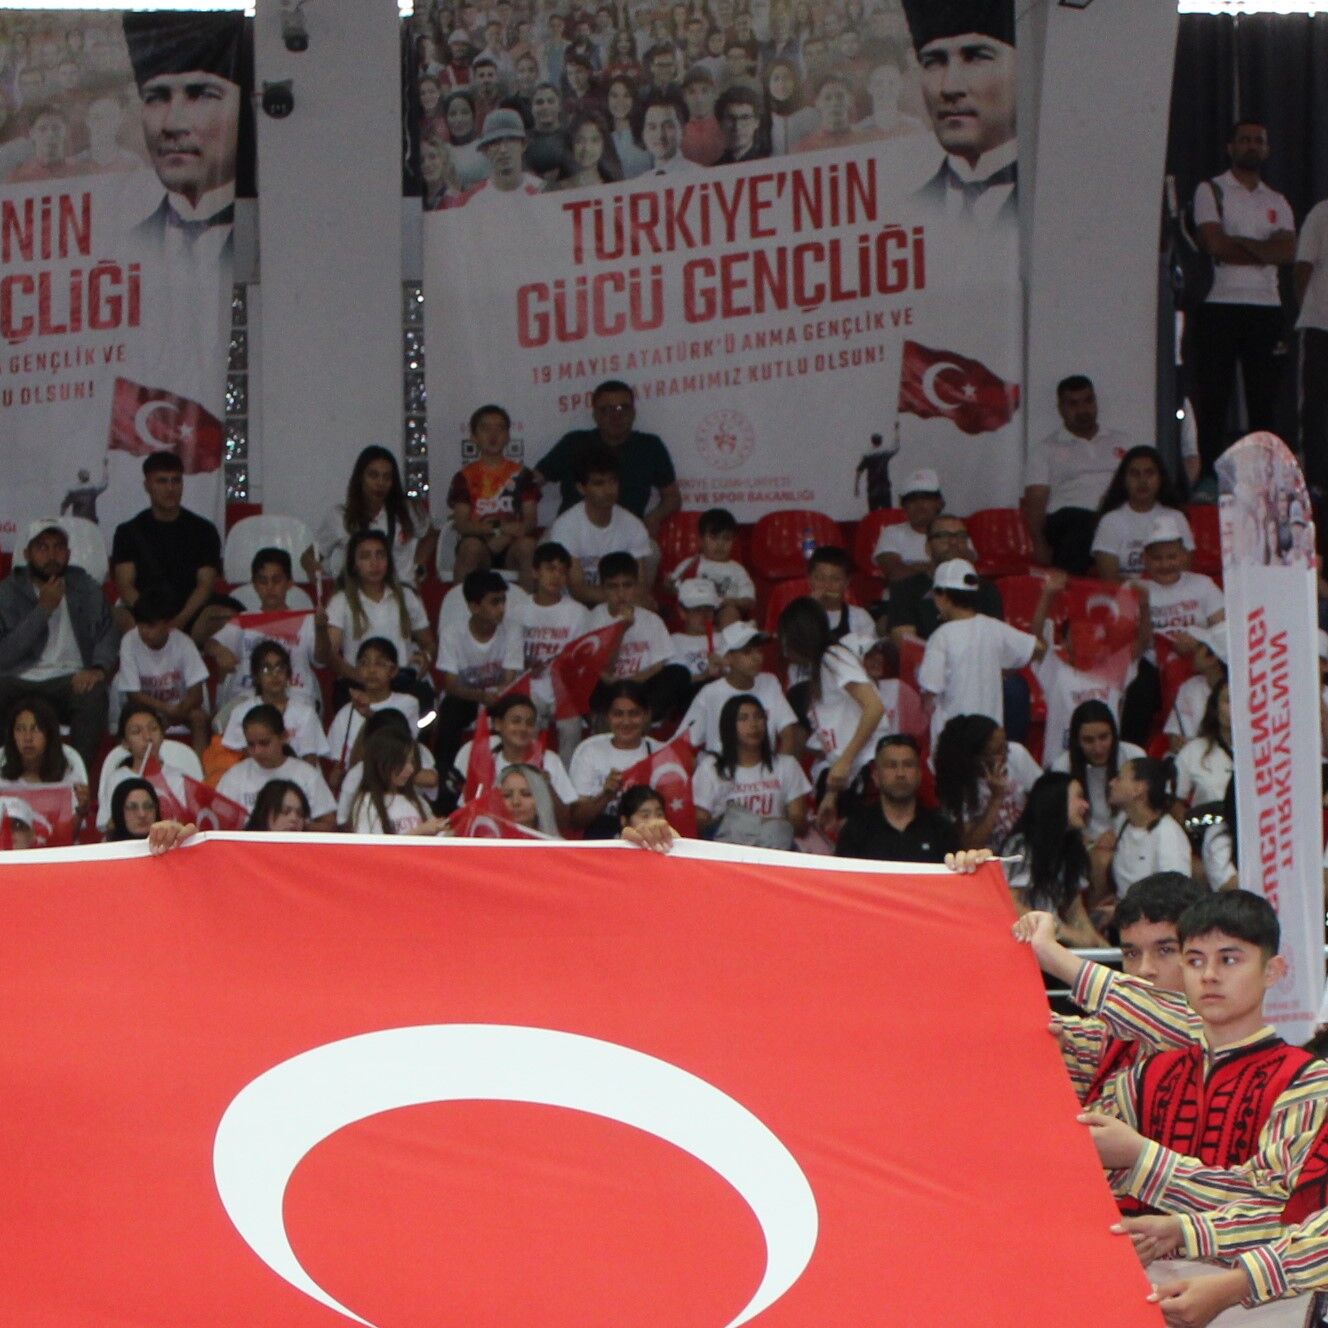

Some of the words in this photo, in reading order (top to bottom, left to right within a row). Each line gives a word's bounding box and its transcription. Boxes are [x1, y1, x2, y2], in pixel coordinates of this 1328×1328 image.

[562, 159, 878, 265] TÜRKİYE'NİN
[516, 265, 664, 349] GÜCÜ
[683, 223, 926, 324] GENÇLİĞİ
[9, 350, 95, 375] GENÇLİK
[103, 344, 128, 364] VE
[532, 366, 552, 385] 19
[559, 356, 620, 381] MAYIS
[742, 328, 796, 351] ANMA
[802, 311, 886, 342] GENÇLİK
[890, 307, 914, 327] VE
[559, 390, 593, 413] SPO
[632, 368, 742, 400] AYRAMIMIZ
[748, 356, 808, 382] KUTLU
[814, 345, 885, 373] OLSUN!
[20, 380, 95, 405] OLSUN!
